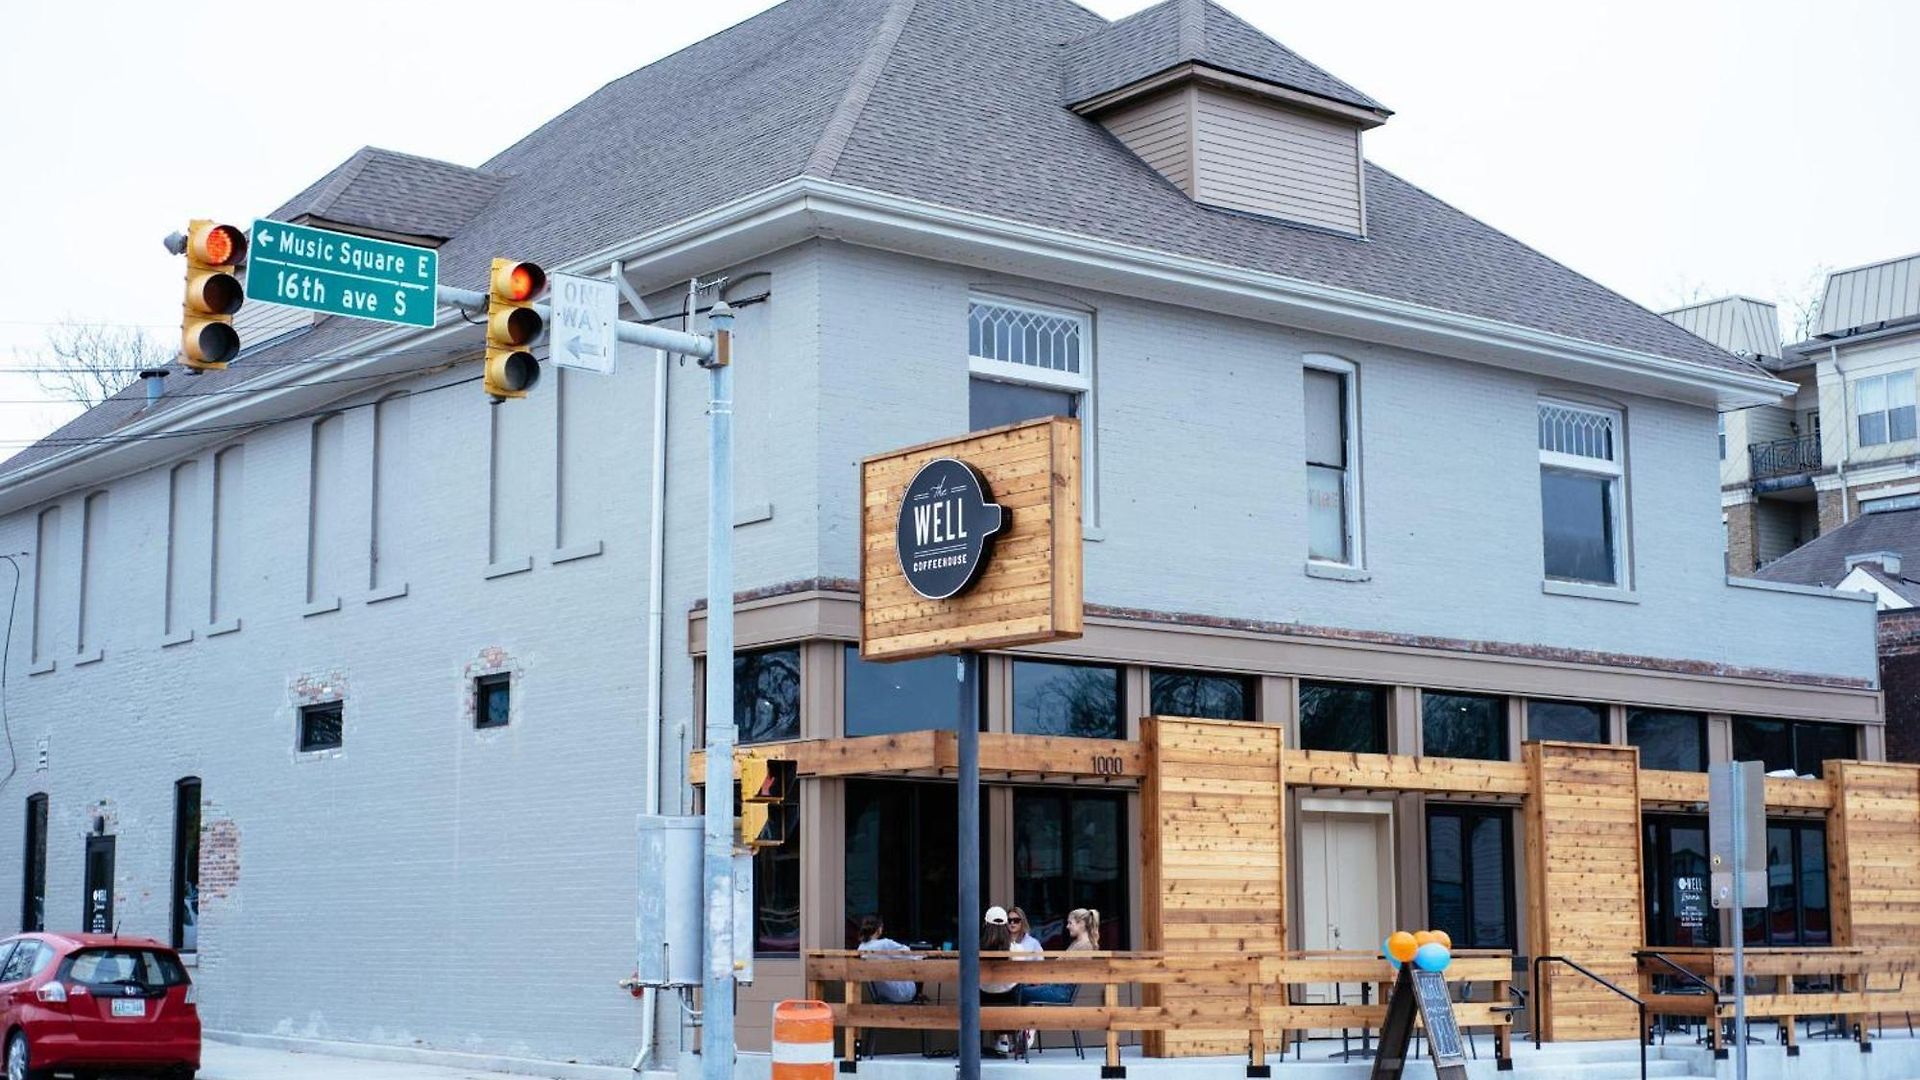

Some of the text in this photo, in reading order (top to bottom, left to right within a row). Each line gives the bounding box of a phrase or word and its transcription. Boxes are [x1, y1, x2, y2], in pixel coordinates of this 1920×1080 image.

[279, 230, 429, 279] Music Square E
[277, 270, 407, 316] 16th ave S
[563, 307, 599, 331] WA
[914, 498, 968, 546] WELL
[913, 554, 968, 572] COFFEEHOUSE
[1091, 756, 1122, 774] 1000
